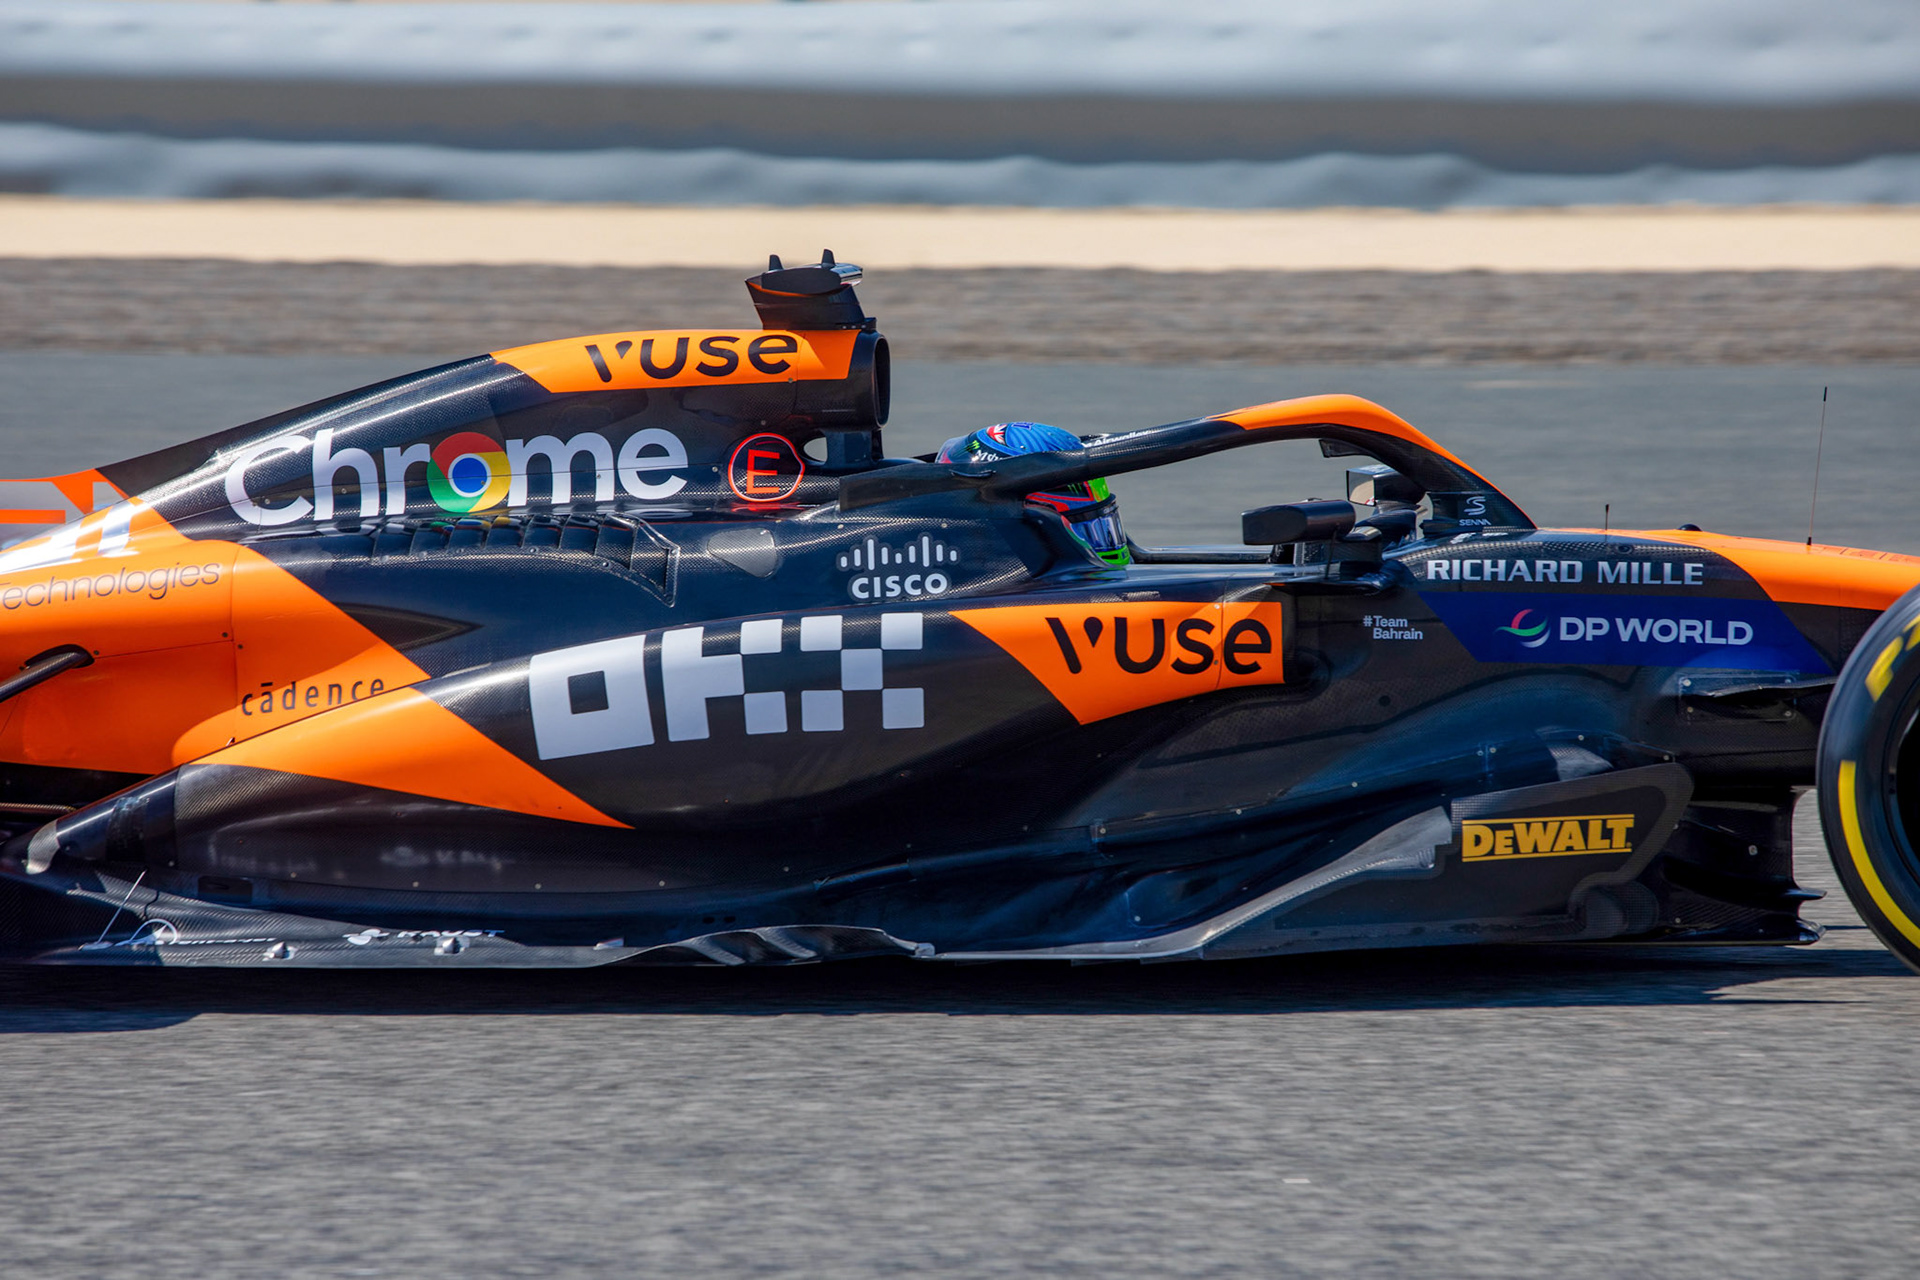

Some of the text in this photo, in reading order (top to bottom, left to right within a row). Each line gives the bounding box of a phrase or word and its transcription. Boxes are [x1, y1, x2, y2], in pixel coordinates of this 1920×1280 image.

[747, 450, 781, 495] E
[1426, 559, 1703, 586] RICHARD MILLE
[1363, 615, 1408, 627] #Team
[1373, 627, 1423, 640] Bahrain
[1559, 616, 1754, 645] DP WORLD
[529, 612, 925, 760] OKX
